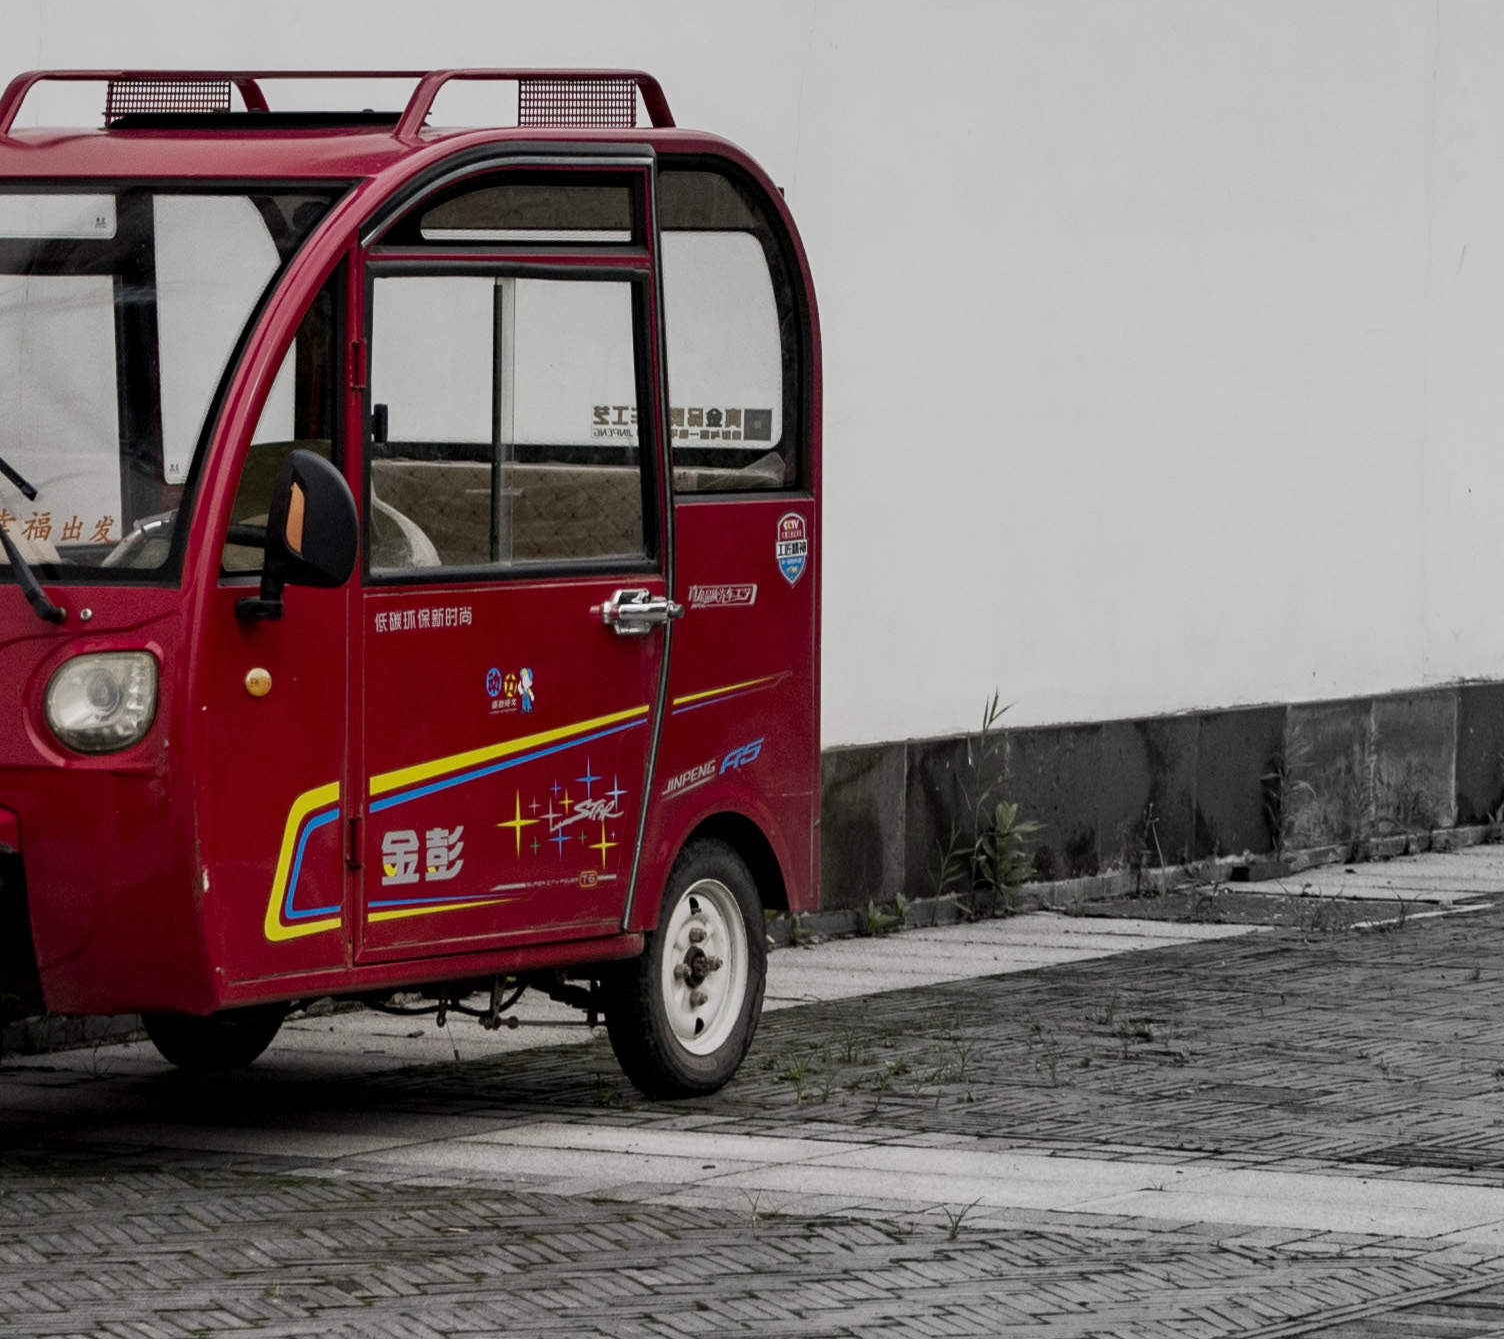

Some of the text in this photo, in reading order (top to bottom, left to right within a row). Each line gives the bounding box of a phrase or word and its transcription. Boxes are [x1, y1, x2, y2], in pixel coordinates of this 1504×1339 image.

[375, 606, 472, 633] 低碳环保新时尚
[661, 759, 716, 796] JINPENG
[381, 826, 464, 886] 金彭
